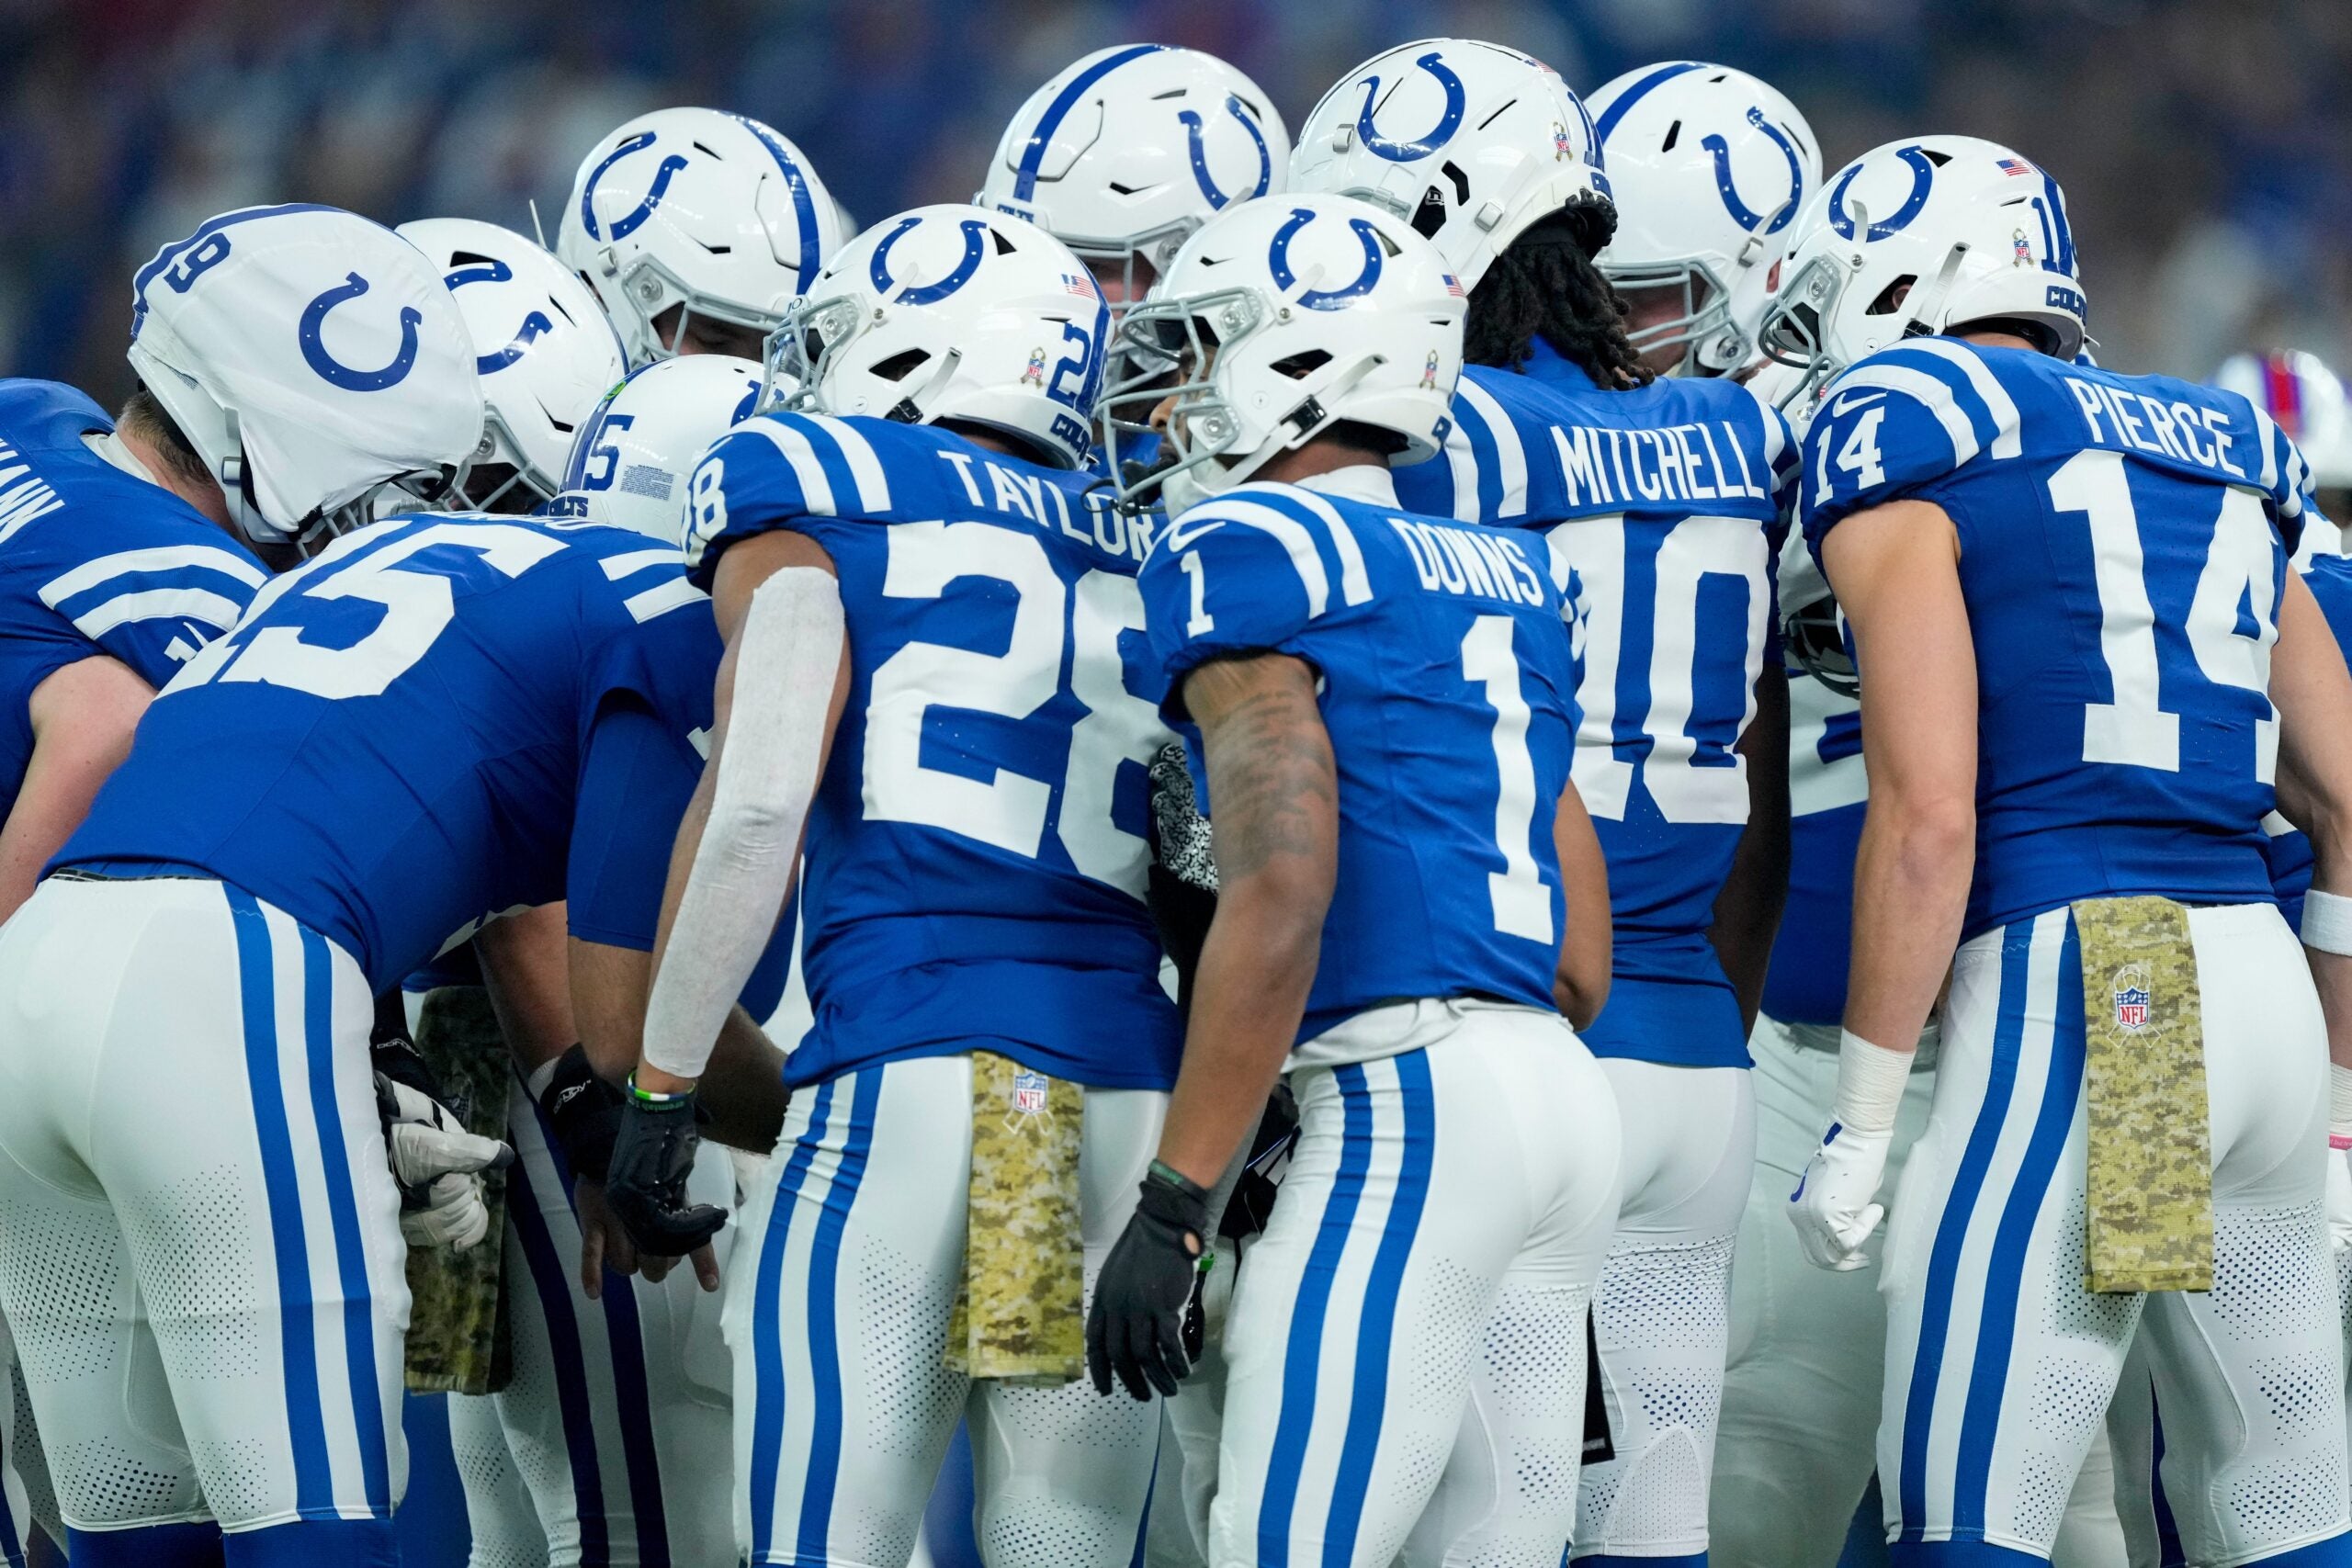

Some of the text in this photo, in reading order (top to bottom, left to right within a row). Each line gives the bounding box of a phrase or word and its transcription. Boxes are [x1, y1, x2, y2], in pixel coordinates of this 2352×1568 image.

[163, 232, 232, 294] 9
[2015, 247, 2030, 258] NFL
[1028, 366, 1042, 378] NFL
[1049, 412, 1091, 461] COLT
[1551, 418, 1766, 507] MITCHELL
[1814, 406, 1886, 508] 14
[2064, 377, 2246, 479] PIERCE
[936, 449, 1155, 562] TAYLOR
[1180, 549, 1215, 638] 1
[1386, 517, 1544, 607] DOWNS
[2047, 448, 2281, 787] 14
[861, 519, 1185, 905] 28
[1545, 512, 1771, 825] 10
[1460, 615, 1555, 946] 1
[2120, 1006, 2147, 1025] NFL
[1018, 1090, 1045, 1111] NFL
